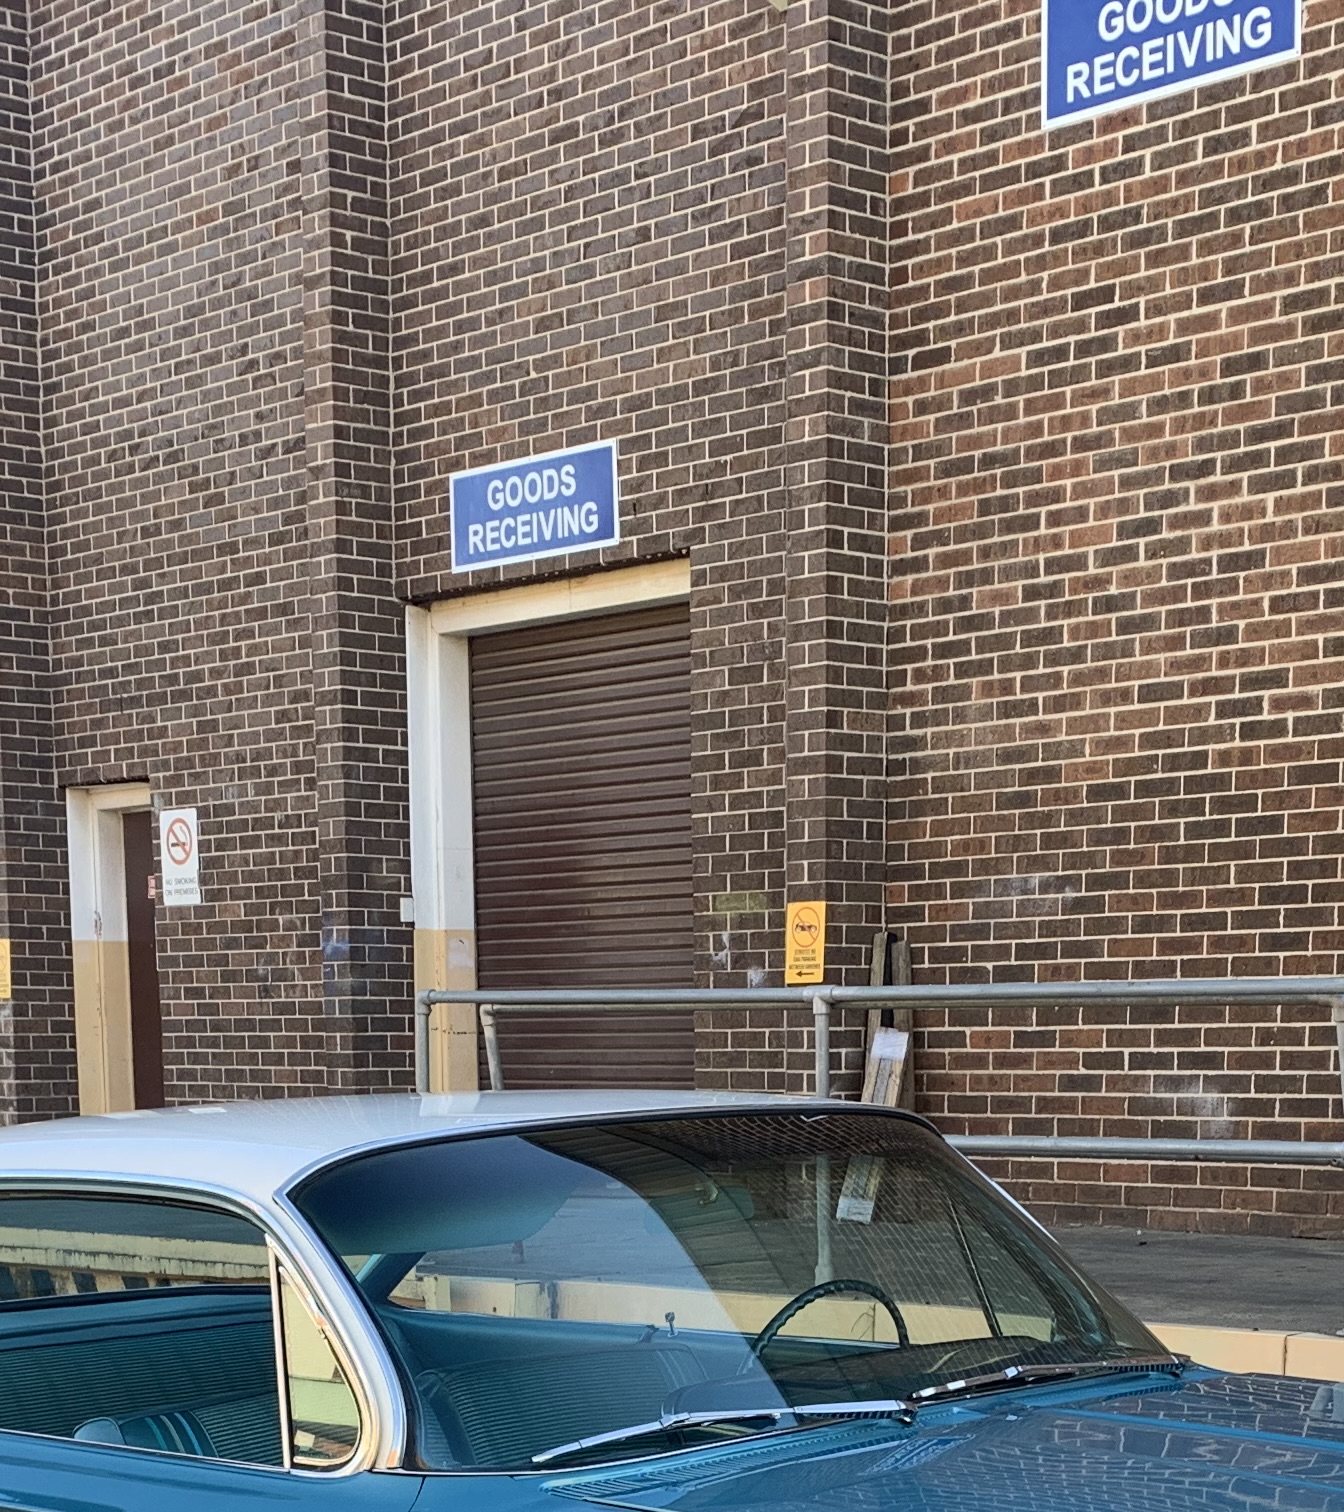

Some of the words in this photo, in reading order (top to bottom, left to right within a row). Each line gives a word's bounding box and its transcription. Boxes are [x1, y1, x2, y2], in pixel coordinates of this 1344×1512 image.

[1098, 0, 1234, 42] GOO
[1066, 6, 1272, 103] RECEIVING
[487, 464, 577, 511] GOODS
[468, 501, 599, 555] RECEIVING
